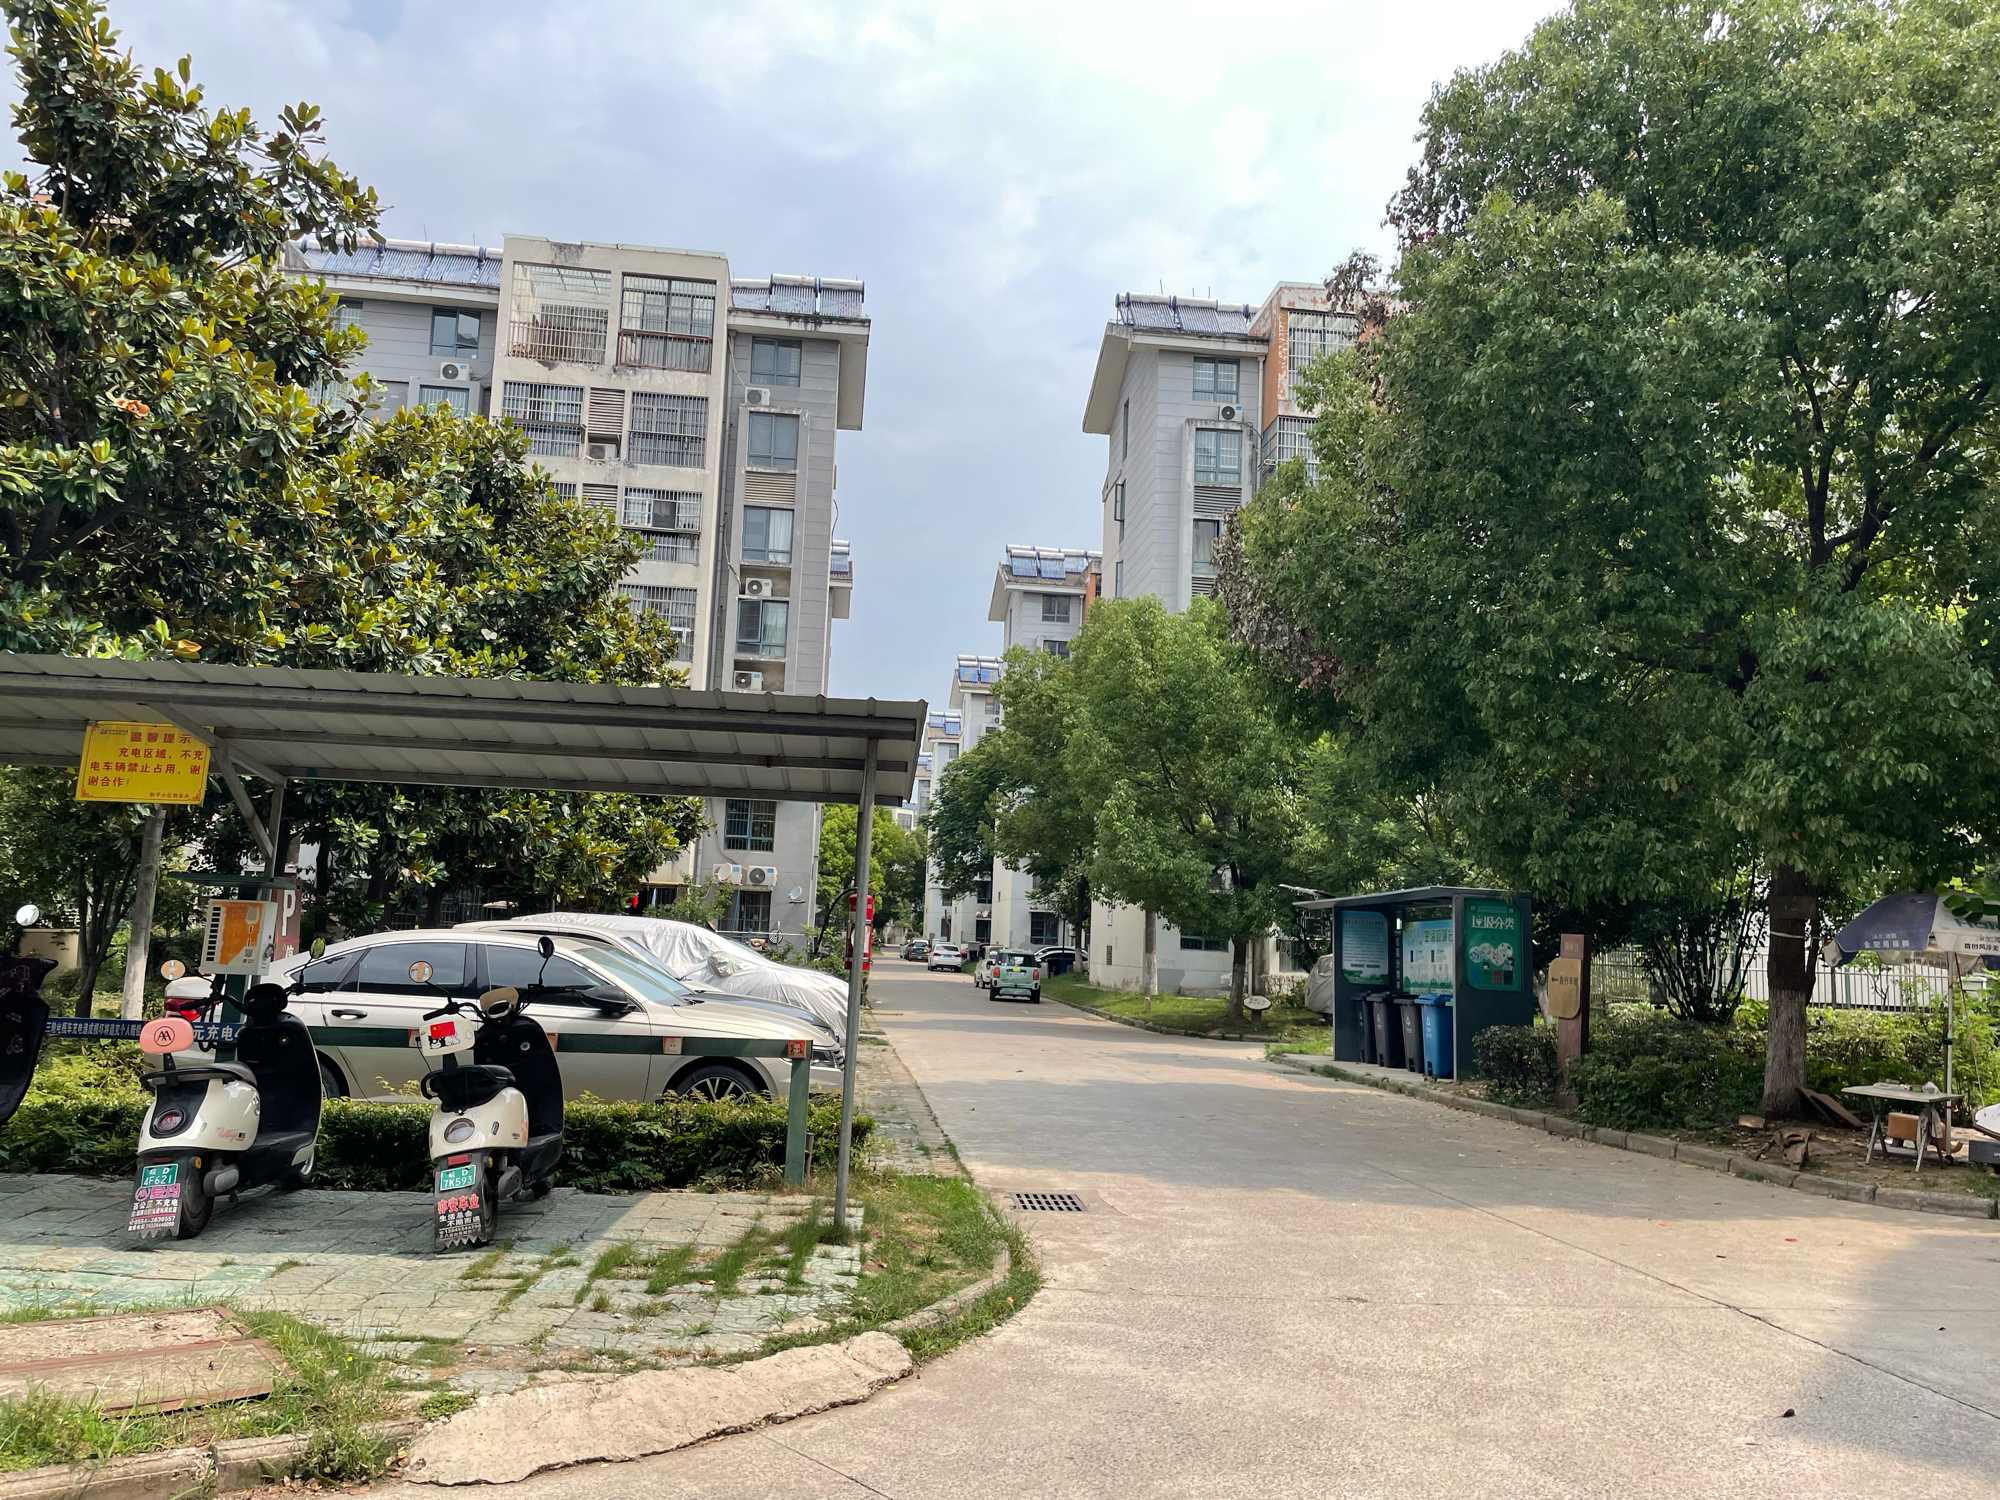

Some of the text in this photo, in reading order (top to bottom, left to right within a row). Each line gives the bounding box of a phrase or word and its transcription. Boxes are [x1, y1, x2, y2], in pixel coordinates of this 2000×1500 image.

[130, 732, 192, 744] 温馨提示
[118, 747, 204, 761] 充电区域，不充
[90, 762, 201, 775] 电车辆禁止占用，谢
[281, 889, 296, 936] P
[1471, 915, 1515, 930] 垃圾分类
[143, 1175, 172, 1186] 4F621
[443, 1176, 473, 1188] 7K593
[437, 1194, 480, 1214] 亦安车业
